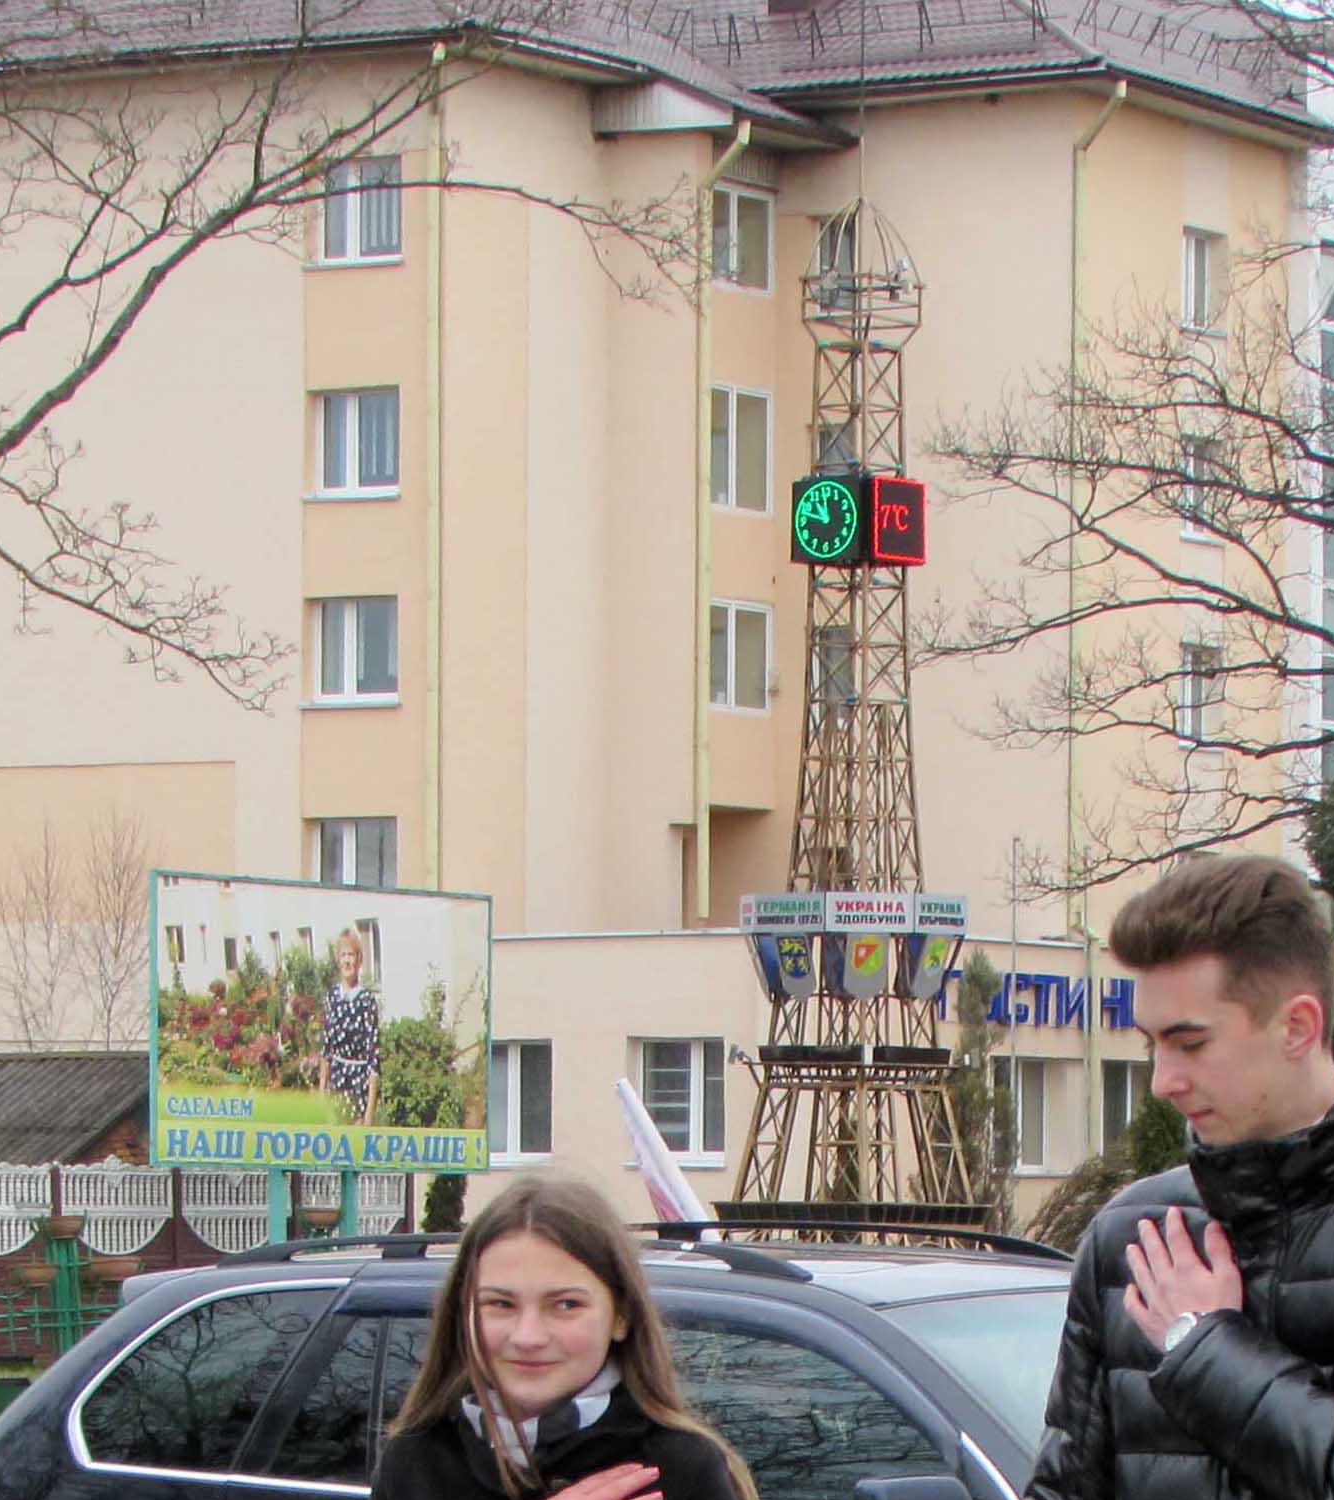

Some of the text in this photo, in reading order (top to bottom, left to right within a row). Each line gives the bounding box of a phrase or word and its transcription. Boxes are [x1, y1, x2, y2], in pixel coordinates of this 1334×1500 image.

[166, 1096, 254, 1118] СДЕЛАЕМ
[166, 1128, 246, 1160] НАШ
[253, 1131, 355, 1164] ГОРОД
[362, 1133, 468, 1164] КРАШЕ
